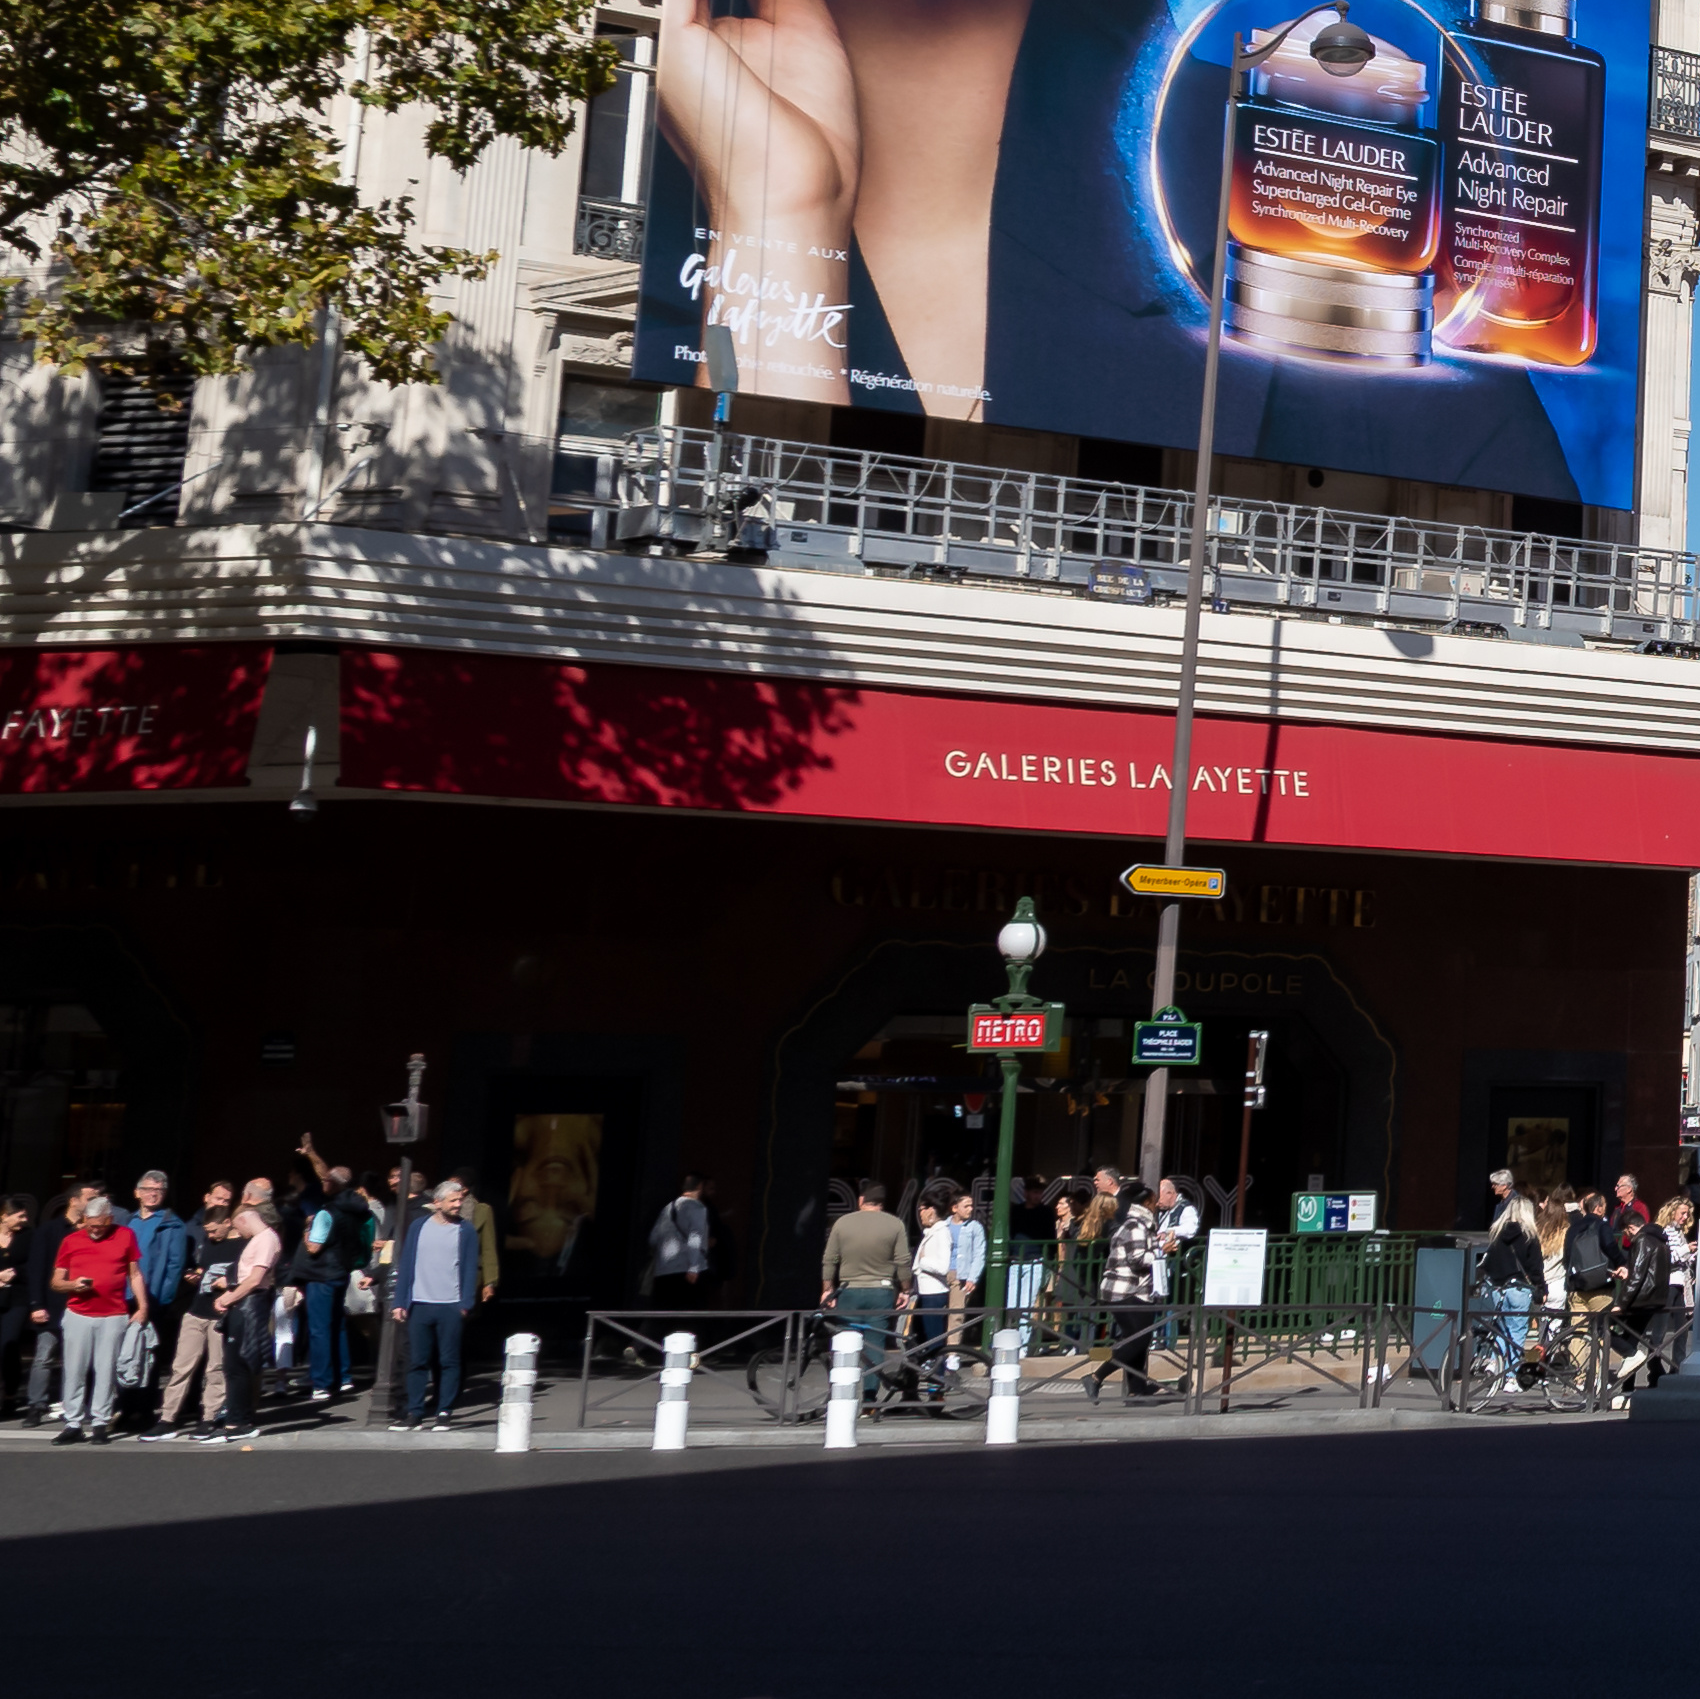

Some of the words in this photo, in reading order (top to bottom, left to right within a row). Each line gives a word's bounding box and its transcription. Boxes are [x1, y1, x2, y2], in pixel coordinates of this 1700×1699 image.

[1459, 107, 1553, 147] LAUDER
[1322, 137, 1405, 171] LAUDER
[1458, 150, 1550, 187] Advanced
[1253, 160, 1318, 185] Advanced
[1320, 172, 1353, 192] Night
[1356, 177, 1394, 198] Repair
[1396, 185, 1418, 204] Eye
[1253, 179, 1340, 209] Supercharged
[1458, 177, 1507, 209] Night
[1512, 187, 1569, 217] Repair
[1252, 200, 1326, 225] Synchronized
[1328, 214, 1409, 242] Multi-Recovery
[1455, 221, 1520, 244] Synchronized
[694, 227, 722, 241] EN
[731, 233, 797, 253] VENTE
[807, 245, 848, 262] AUX
[1454, 236, 1527, 260] Multi-Recovery
[1528, 248, 1571, 266] Complex
[679, 248, 795, 301] Galeries
[706, 291, 855, 348] Lafayette
[850, 368, 935, 393] Régénération
[936, 384, 993, 401] naturelle.
[945, 749, 1117, 788] GALERIES
[1129, 761, 1310, 798] LAAYETTE
[1089, 967, 1131, 990] LA
